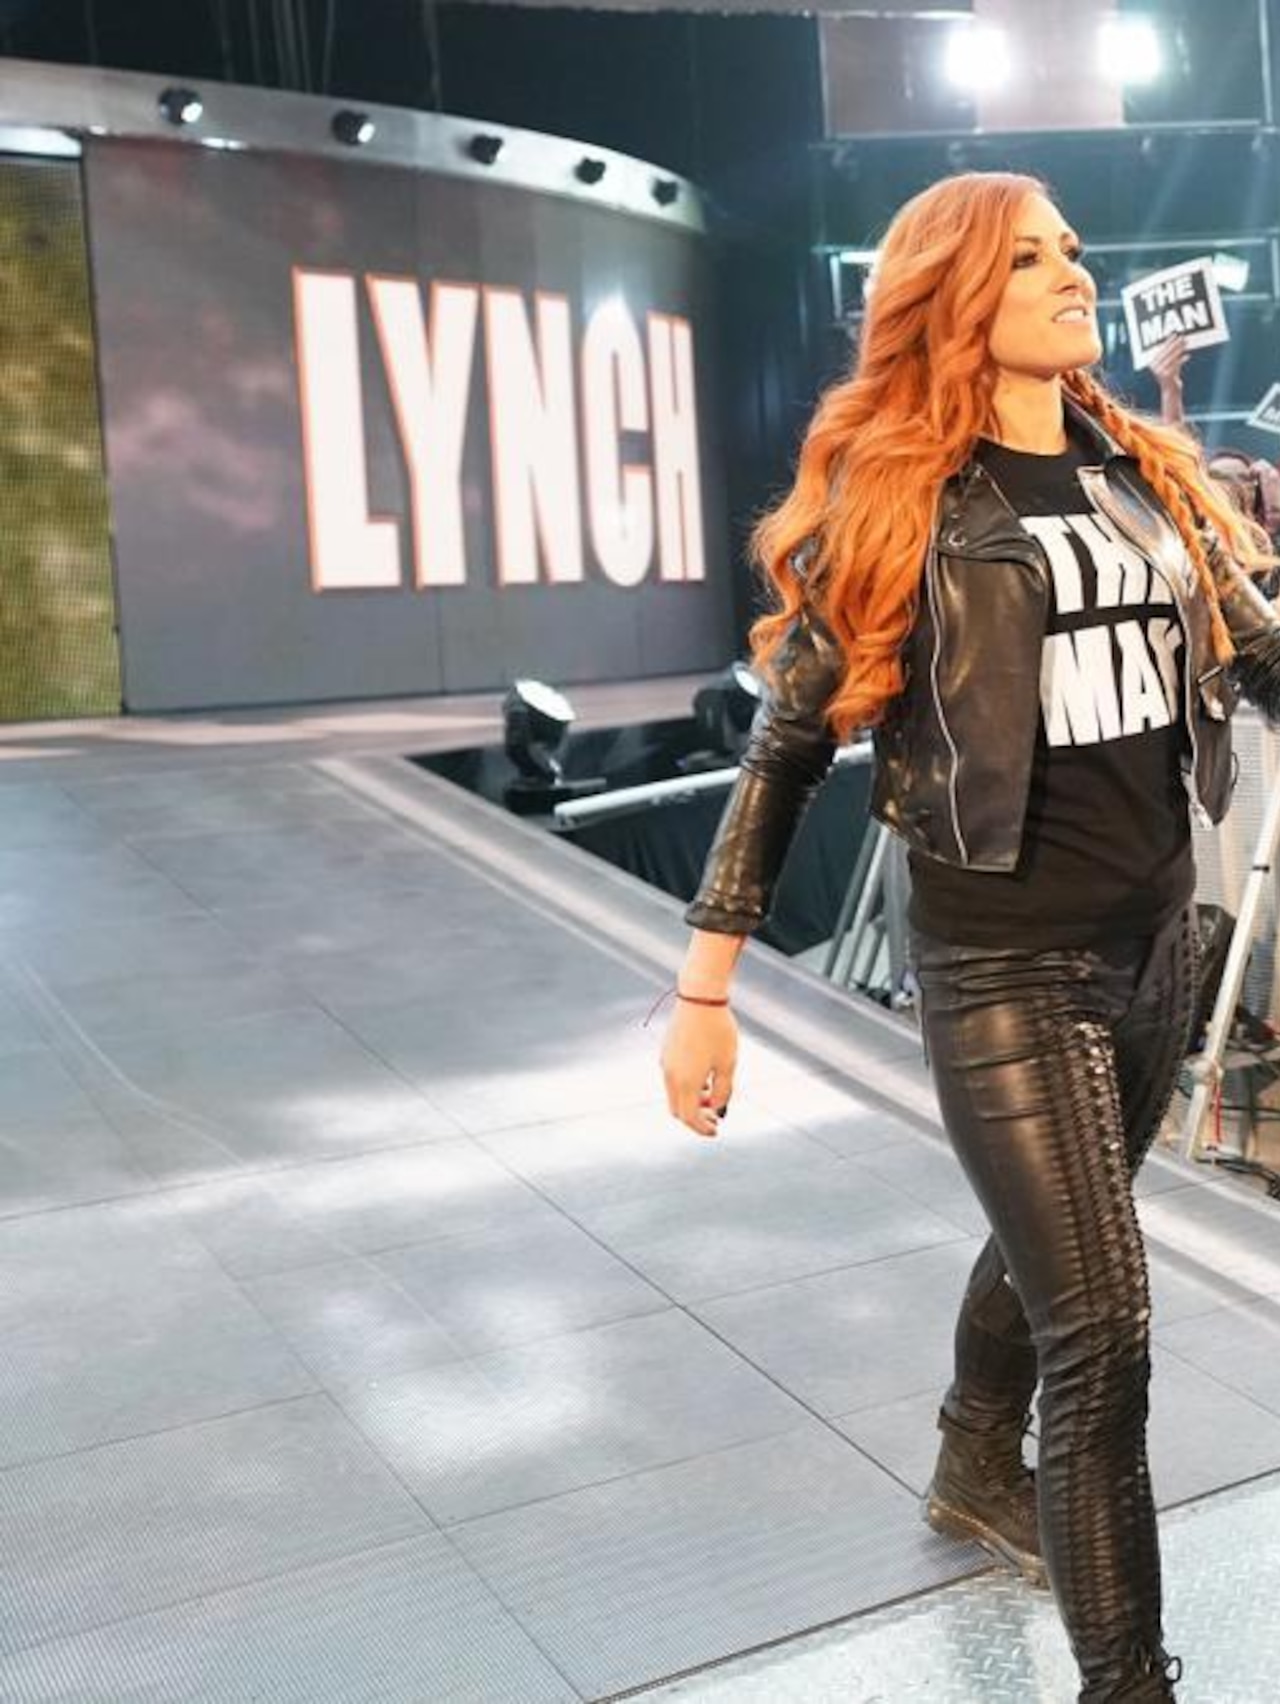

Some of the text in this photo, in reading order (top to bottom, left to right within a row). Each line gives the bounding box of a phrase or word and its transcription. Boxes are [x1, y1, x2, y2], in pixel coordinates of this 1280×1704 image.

[1140, 275, 1196, 313] THE
[1140, 300, 1209, 347] MAN
[292, 265, 706, 592] LYNCH
